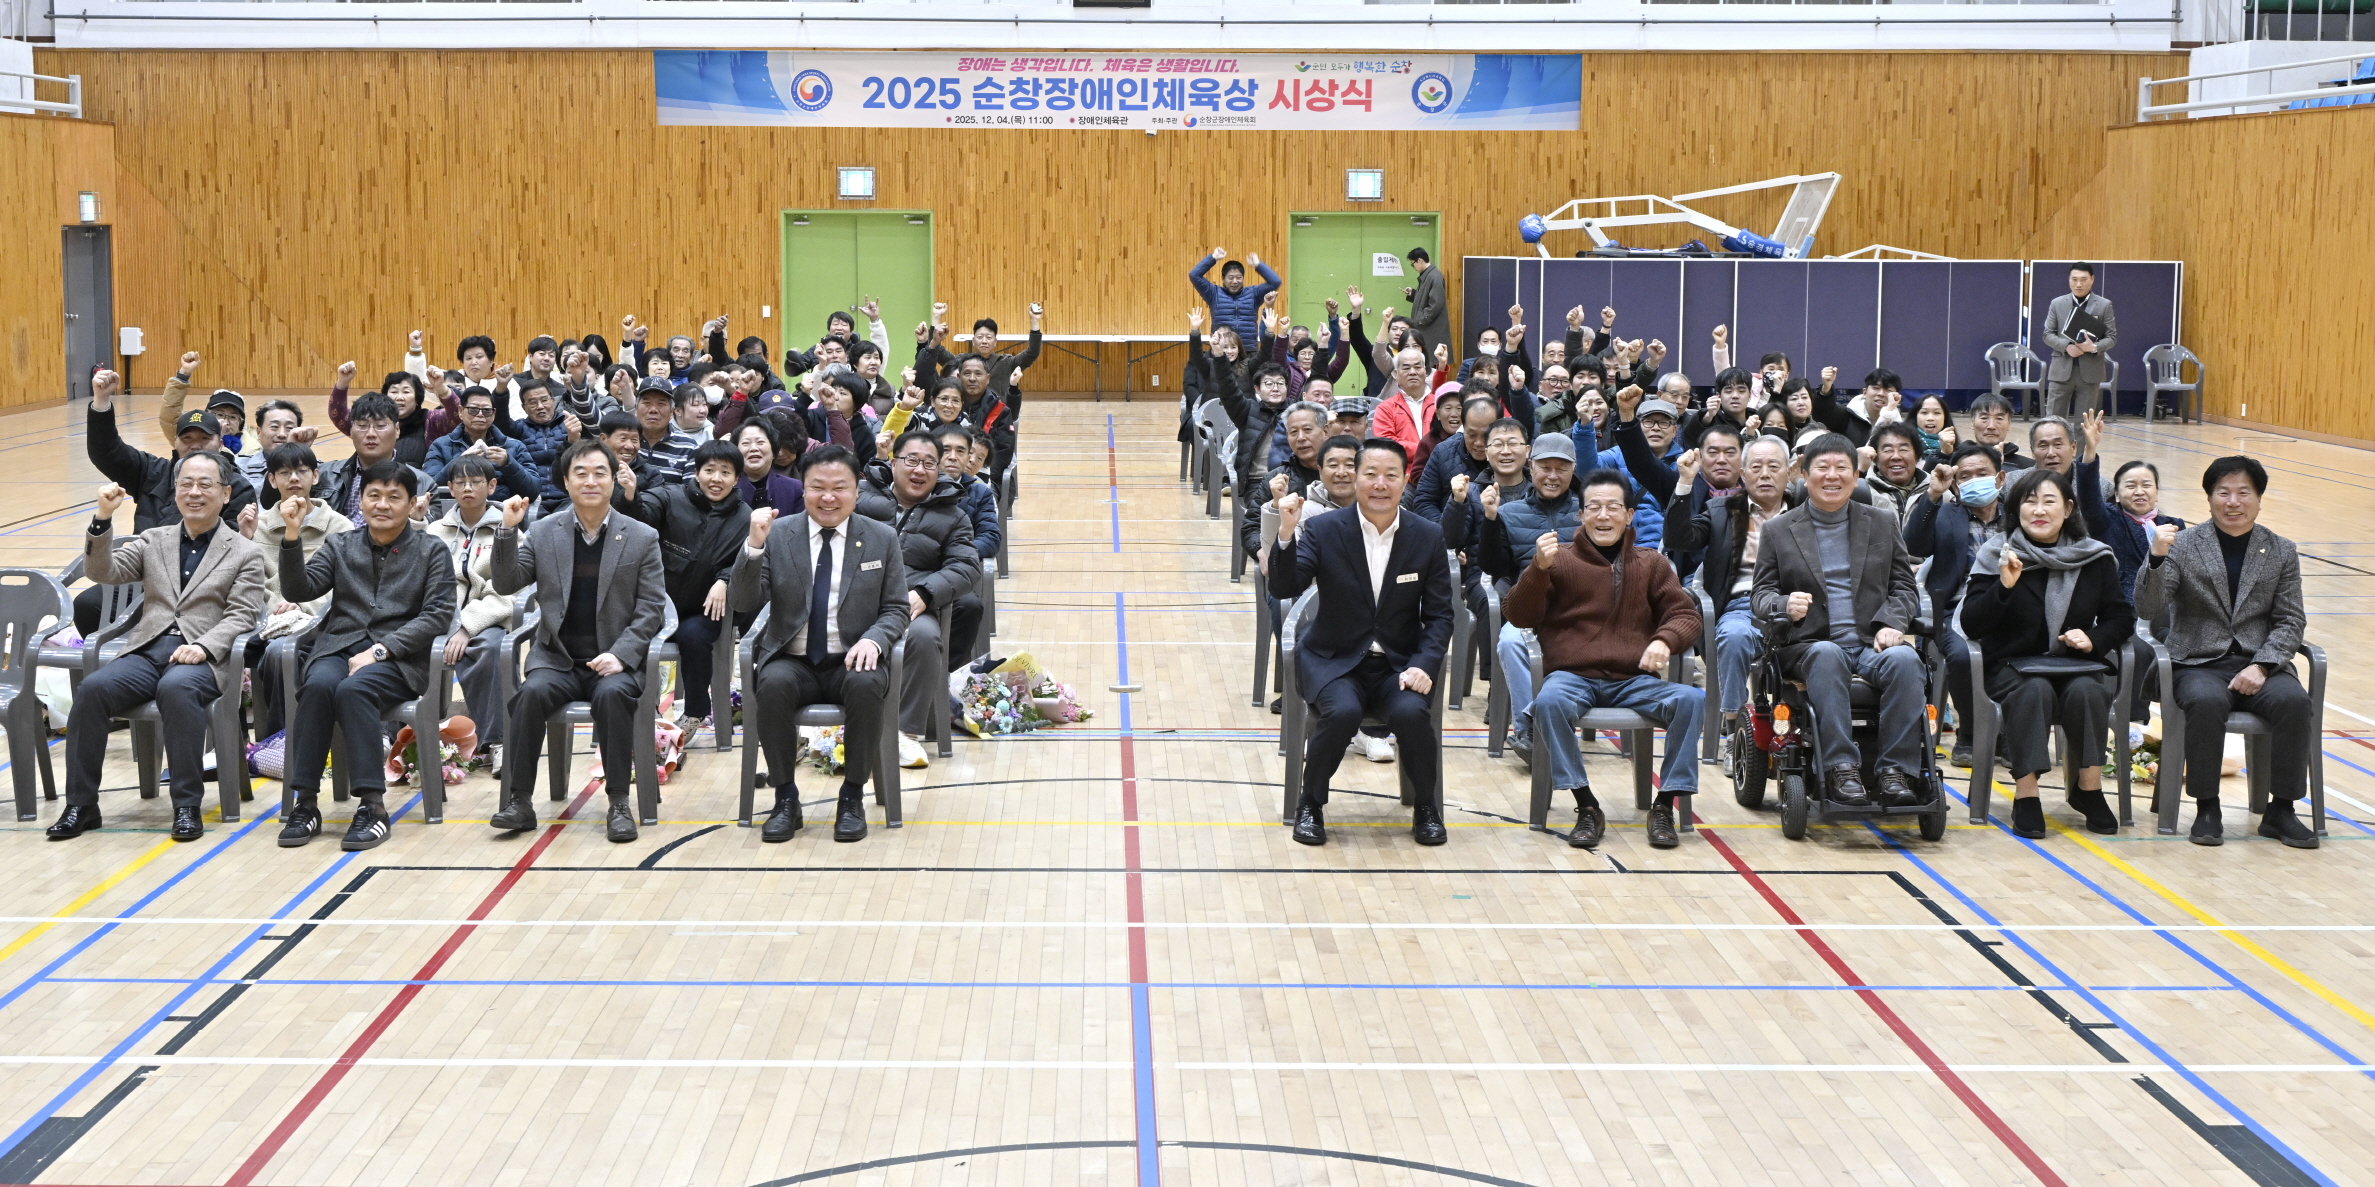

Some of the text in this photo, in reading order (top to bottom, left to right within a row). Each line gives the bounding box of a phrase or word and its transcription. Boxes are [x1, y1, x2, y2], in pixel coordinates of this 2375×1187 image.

[957, 57, 1240, 74] 장애는 생각입니다. 체육은 생활입니다.
[1353, 60, 1387, 74] 행복한
[1389, 60, 1413, 75] 순창
[861, 76, 962, 110] 2025
[972, 76, 1259, 112] 순창장애인체육상
[1268, 78, 1373, 113] 시상식
[954, 115, 979, 124] 2025.
[981, 115, 995, 124] 12.
[1028, 116, 1054, 125] 11:00
[1077, 116, 1129, 126] 장애인체육관
[1199, 116, 1257, 124] 순창군장애인체육회
